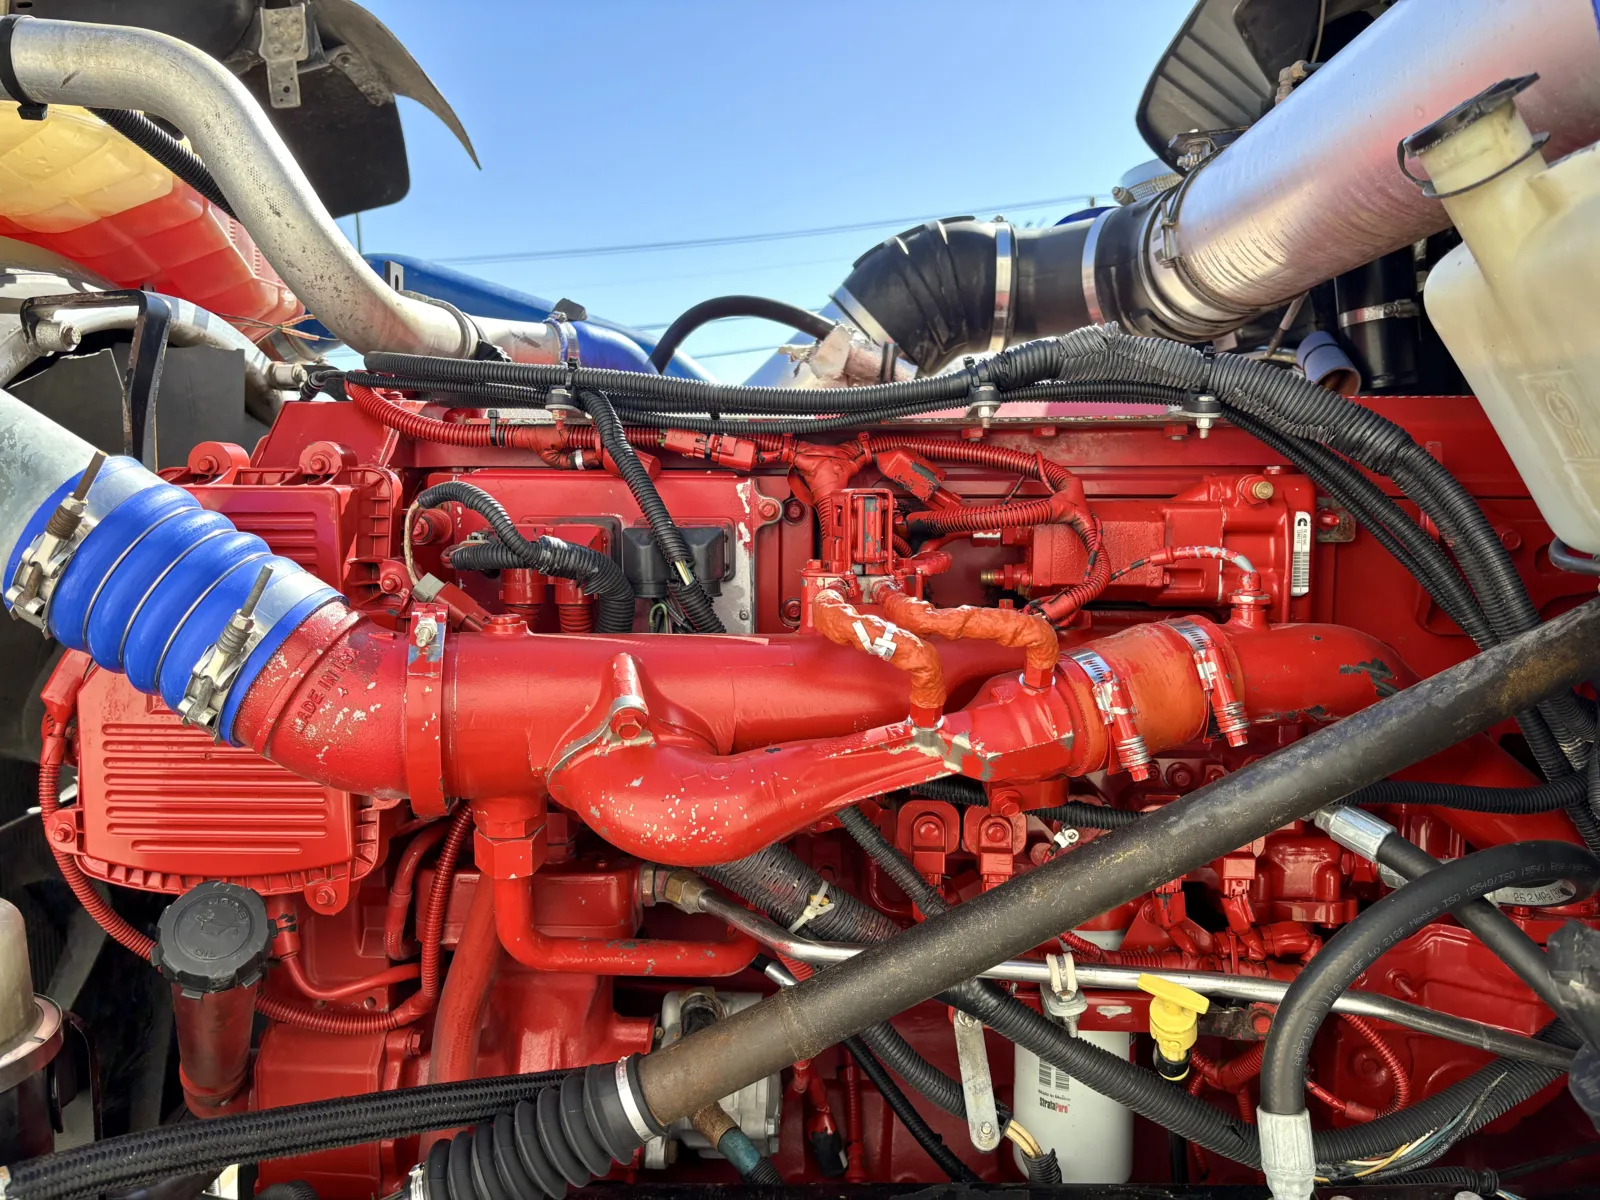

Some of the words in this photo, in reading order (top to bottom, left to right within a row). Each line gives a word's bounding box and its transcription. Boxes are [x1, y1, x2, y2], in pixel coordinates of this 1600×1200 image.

[288, 689, 325, 734] MADE
[318, 670, 340, 691] IN
[1513, 892, 1535, 903] 26.2
[1535, 893, 1553, 902] MPa
[1367, 947, 1381, 957] to
[1382, 926, 1405, 947] 212F
[1408, 906, 1439, 928] Meets
[1442, 893, 1461, 907] ISO
[194, 948, 217, 959] OIL
[1038, 1089, 1049, 1097] Made
